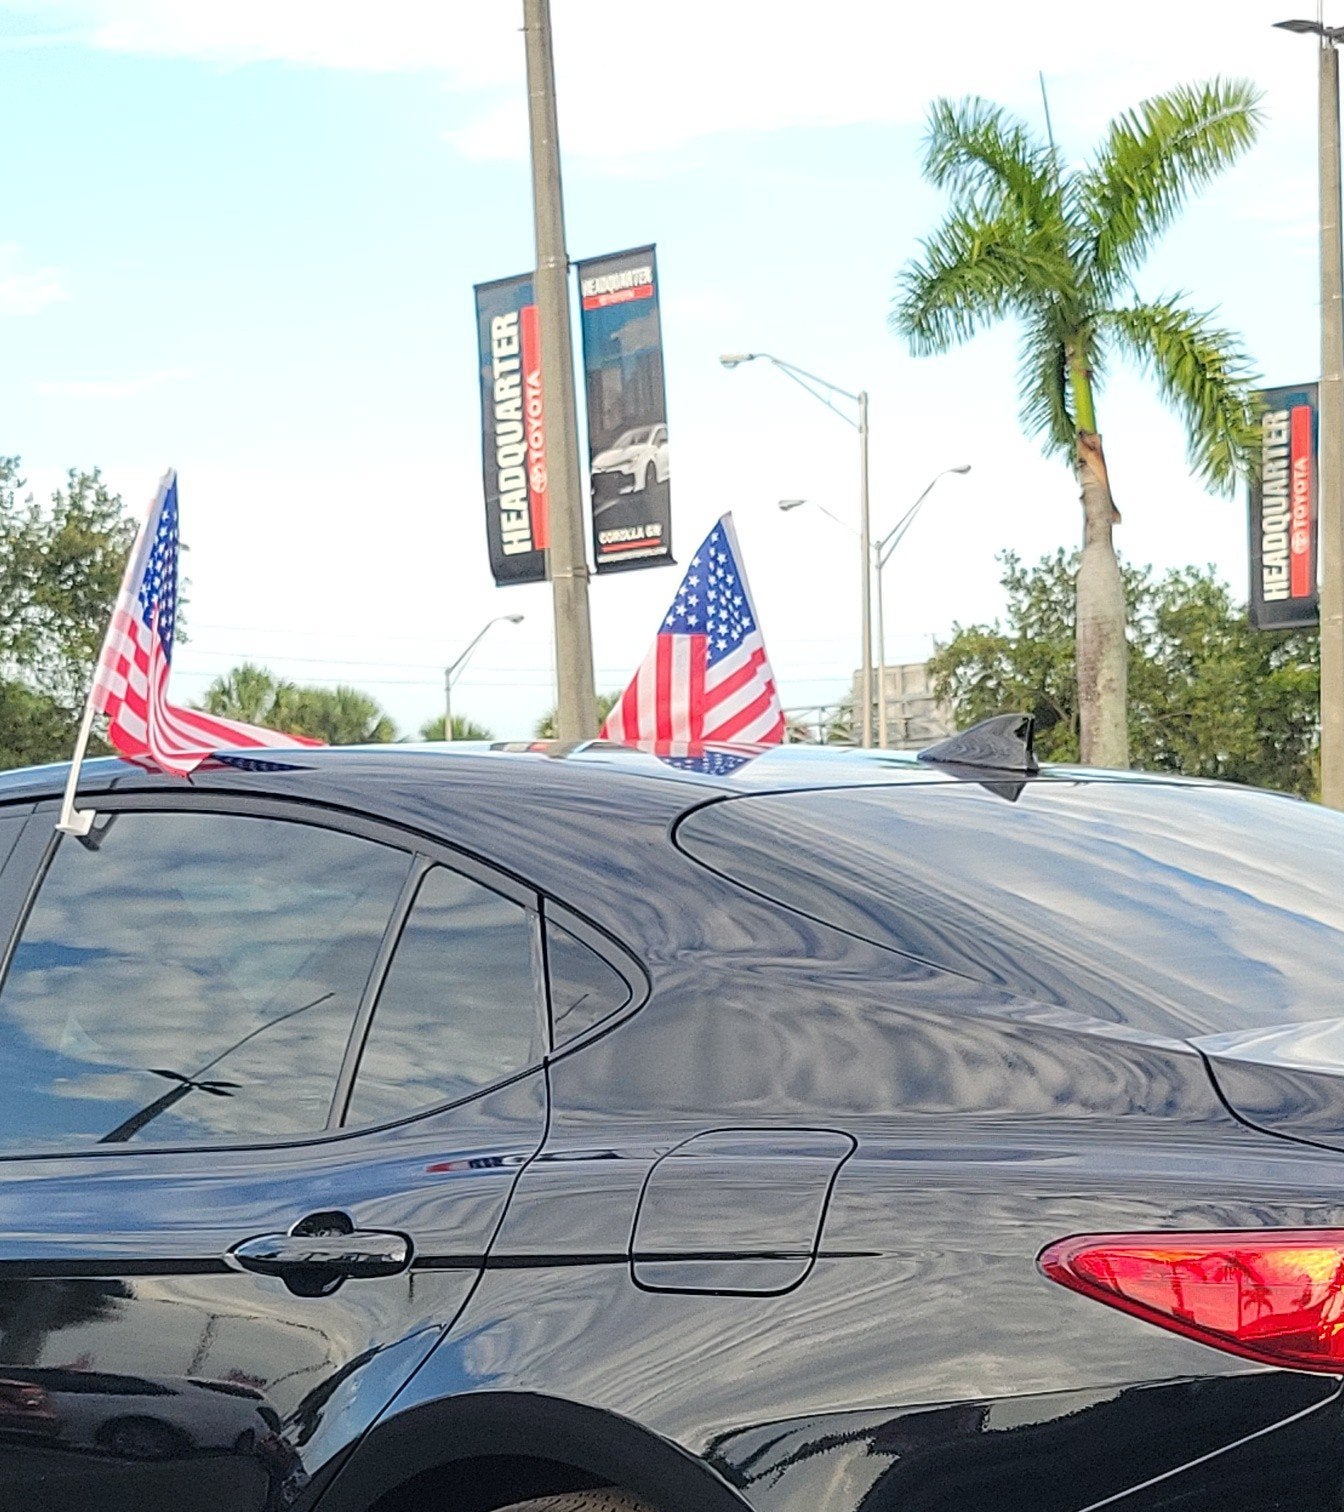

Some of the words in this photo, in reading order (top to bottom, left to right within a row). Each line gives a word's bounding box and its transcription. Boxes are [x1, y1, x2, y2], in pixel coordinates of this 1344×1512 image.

[491, 311, 533, 556] HEADQUARTER
[526, 367, 546, 465] TOYOTA
[1261, 410, 1291, 602] HEADQUARTER
[1293, 456, 1310, 532] TOYOTA
